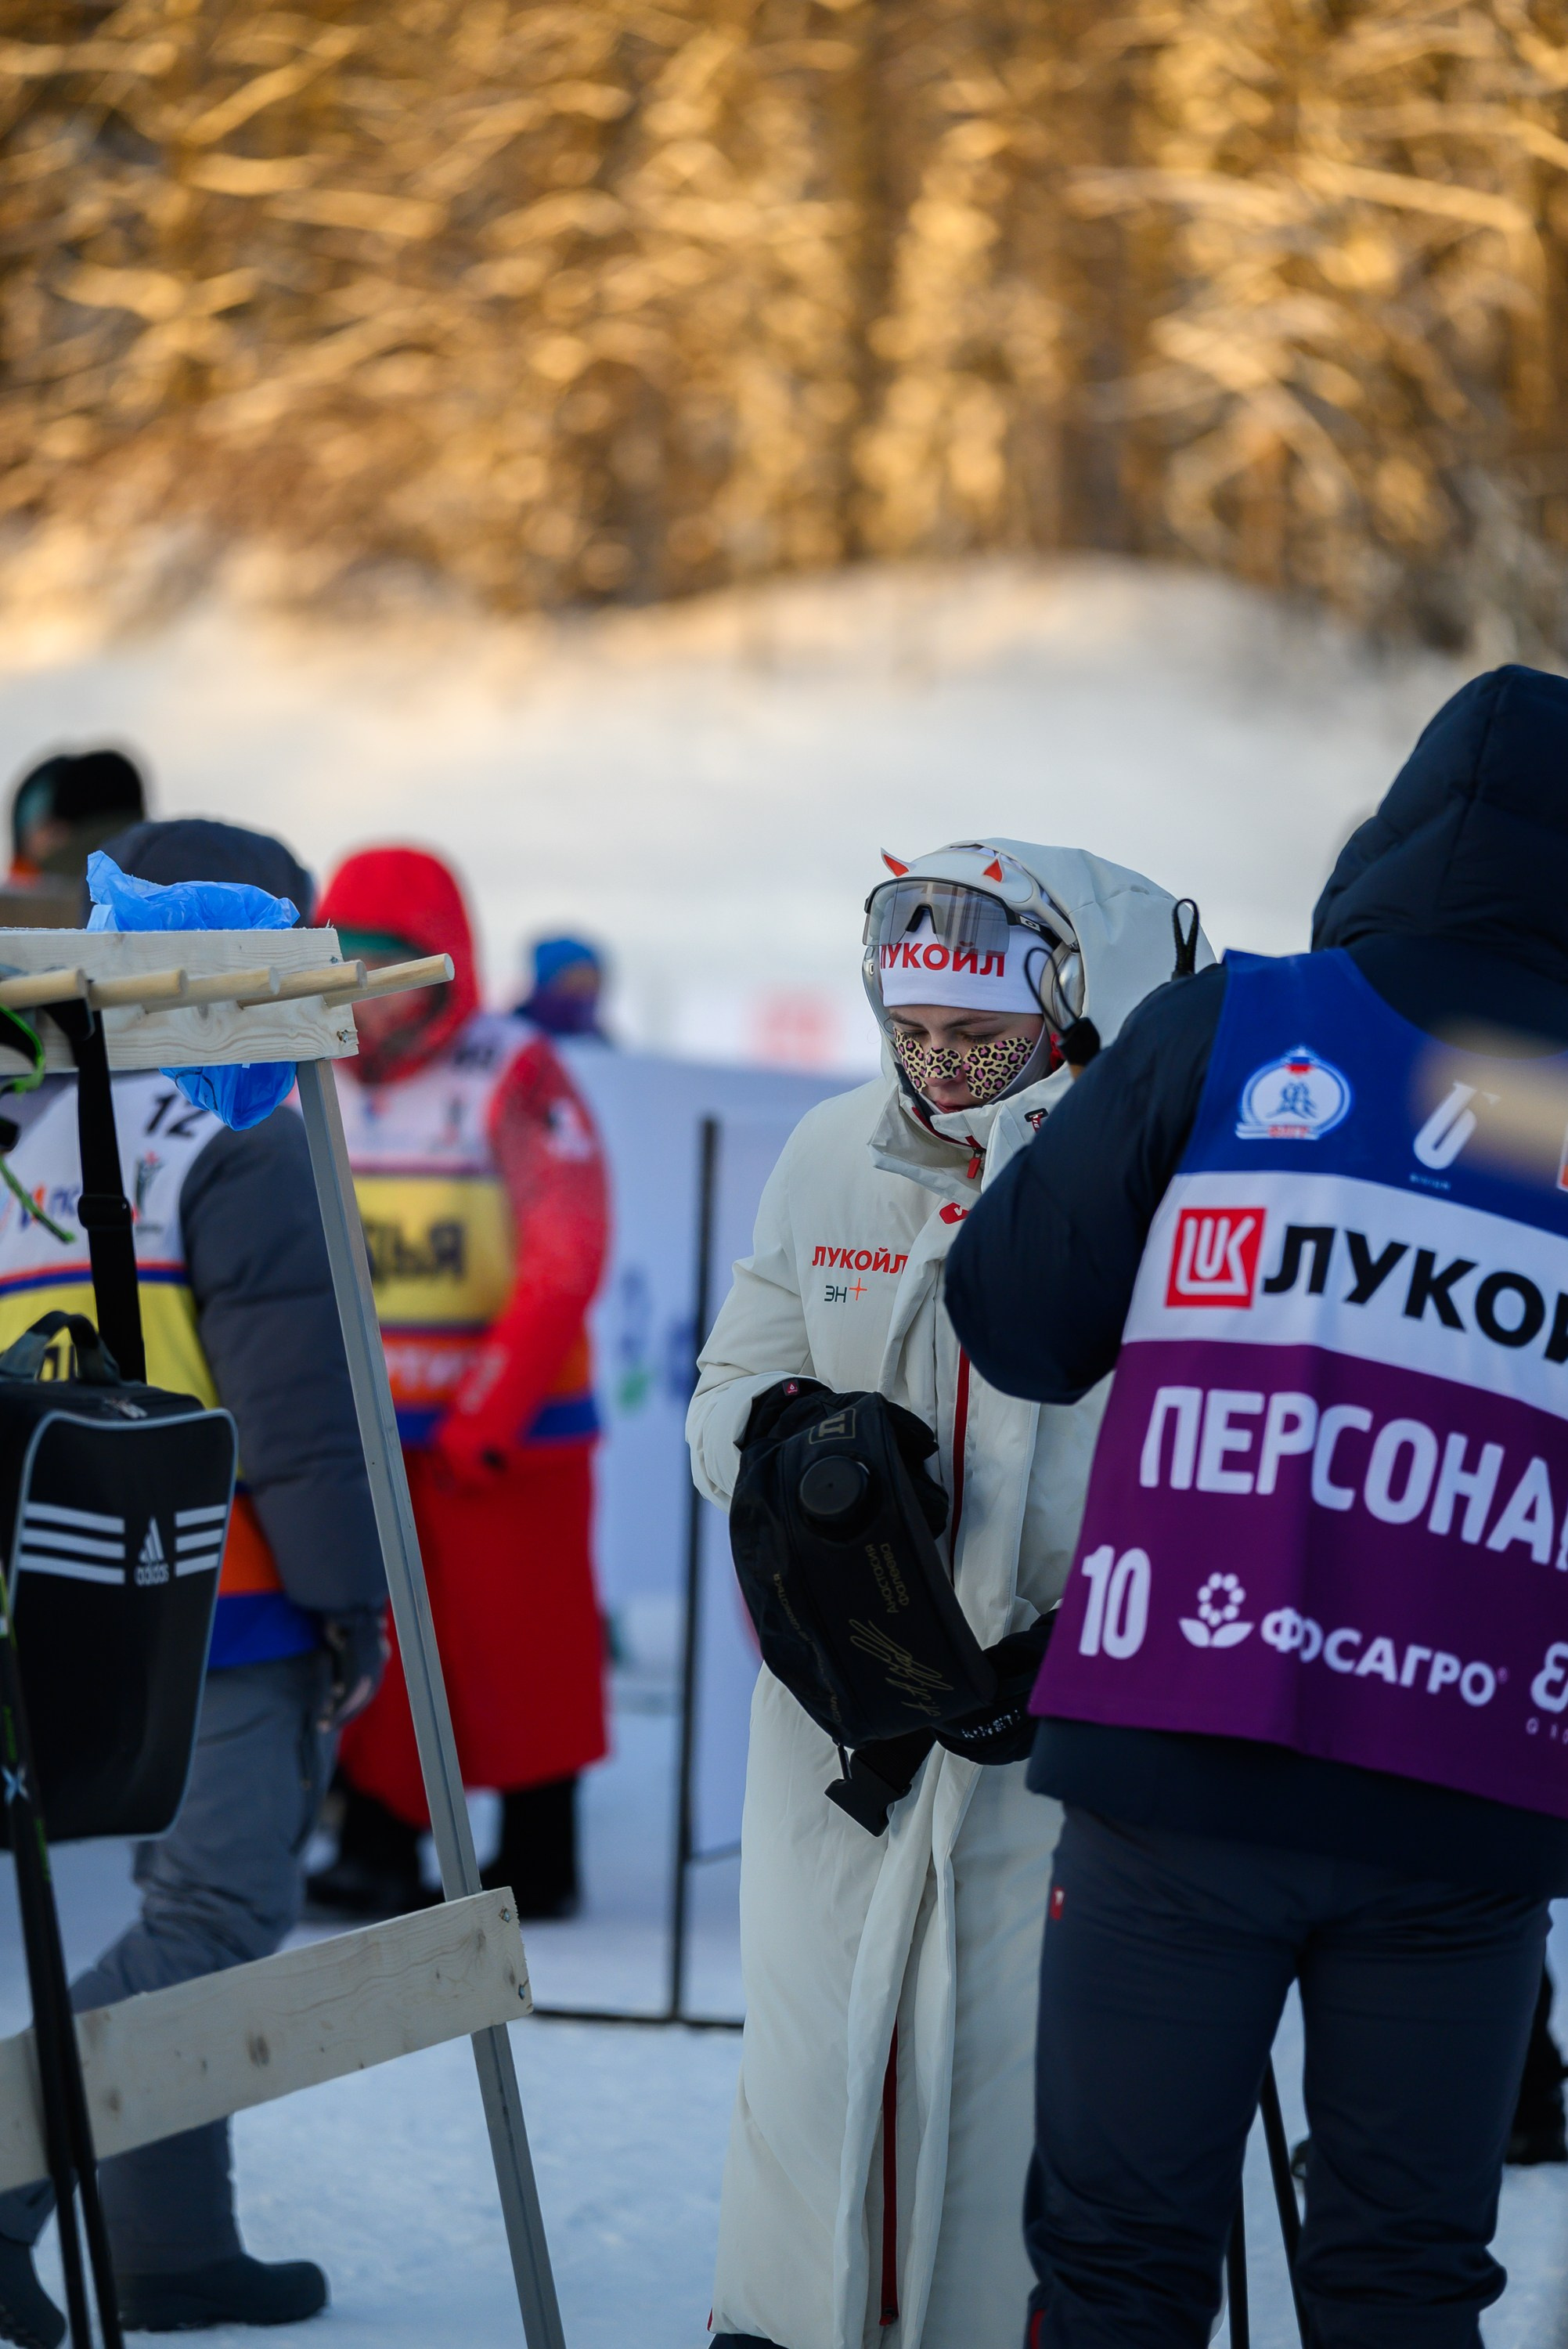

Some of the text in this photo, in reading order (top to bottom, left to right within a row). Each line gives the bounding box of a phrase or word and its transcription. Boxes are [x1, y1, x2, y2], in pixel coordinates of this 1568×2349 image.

[812, 1246, 909, 1275] ЛУКОЙЛ
[135, 1563, 170, 1587] adidas
[1078, 1544, 1152, 1660] 10
